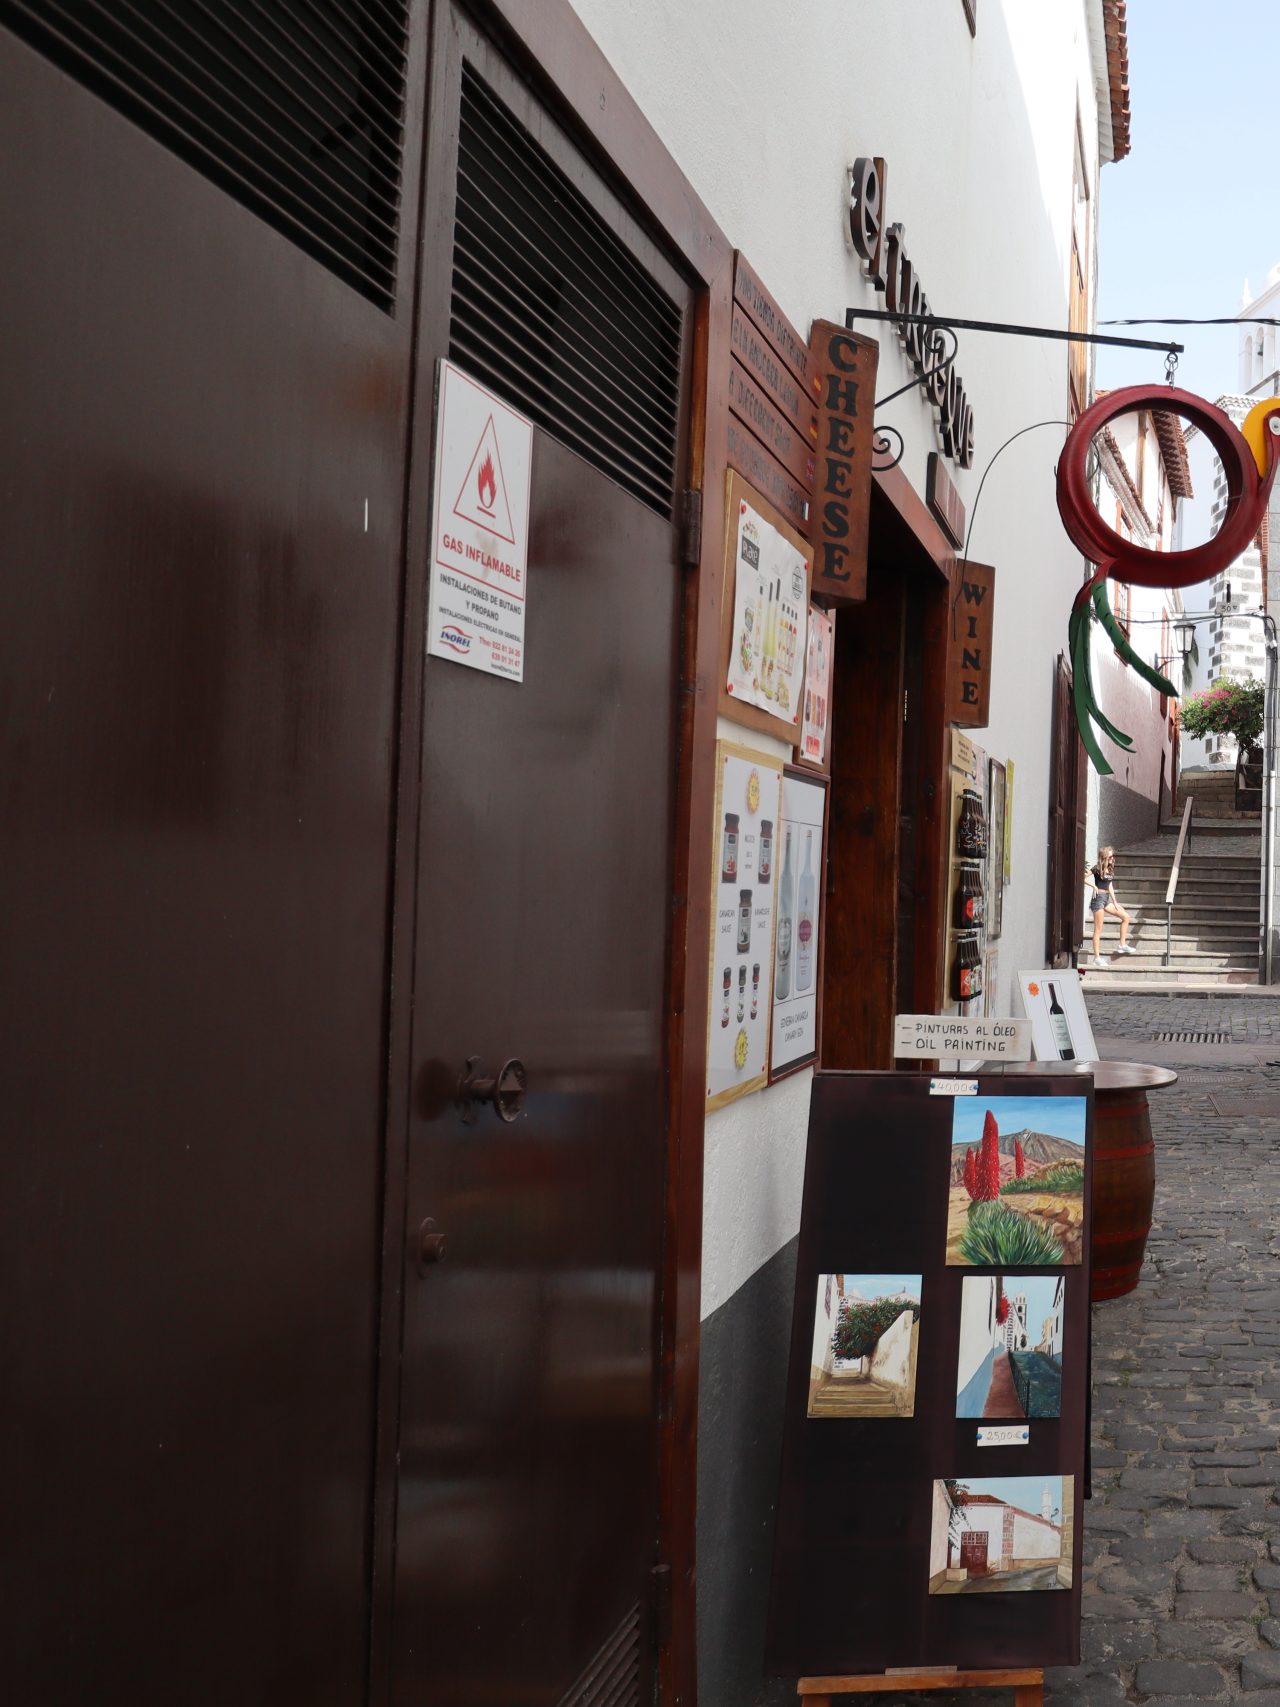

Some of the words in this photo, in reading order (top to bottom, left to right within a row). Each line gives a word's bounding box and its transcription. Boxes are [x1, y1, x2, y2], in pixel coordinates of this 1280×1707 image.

[821, 335, 858, 582] CHEESE
[443, 534, 463, 554] GAS
[466, 544, 521, 582] INFLAMABLE
[440, 573, 489, 601] INSTALACIONES
[490, 594, 498, 606] DE
[499, 597, 522, 615] BUTANO
[438, 606, 473, 625] INSTALACIONES
[465, 601, 470, 610] Y
[471, 602, 499, 621] PROPANO
[440, 631, 471, 648] INOREL
[962, 582, 986, 705] WINE
[976, 1027, 989, 1036] AL
[993, 1022, 1016, 1036] ÓLEO
